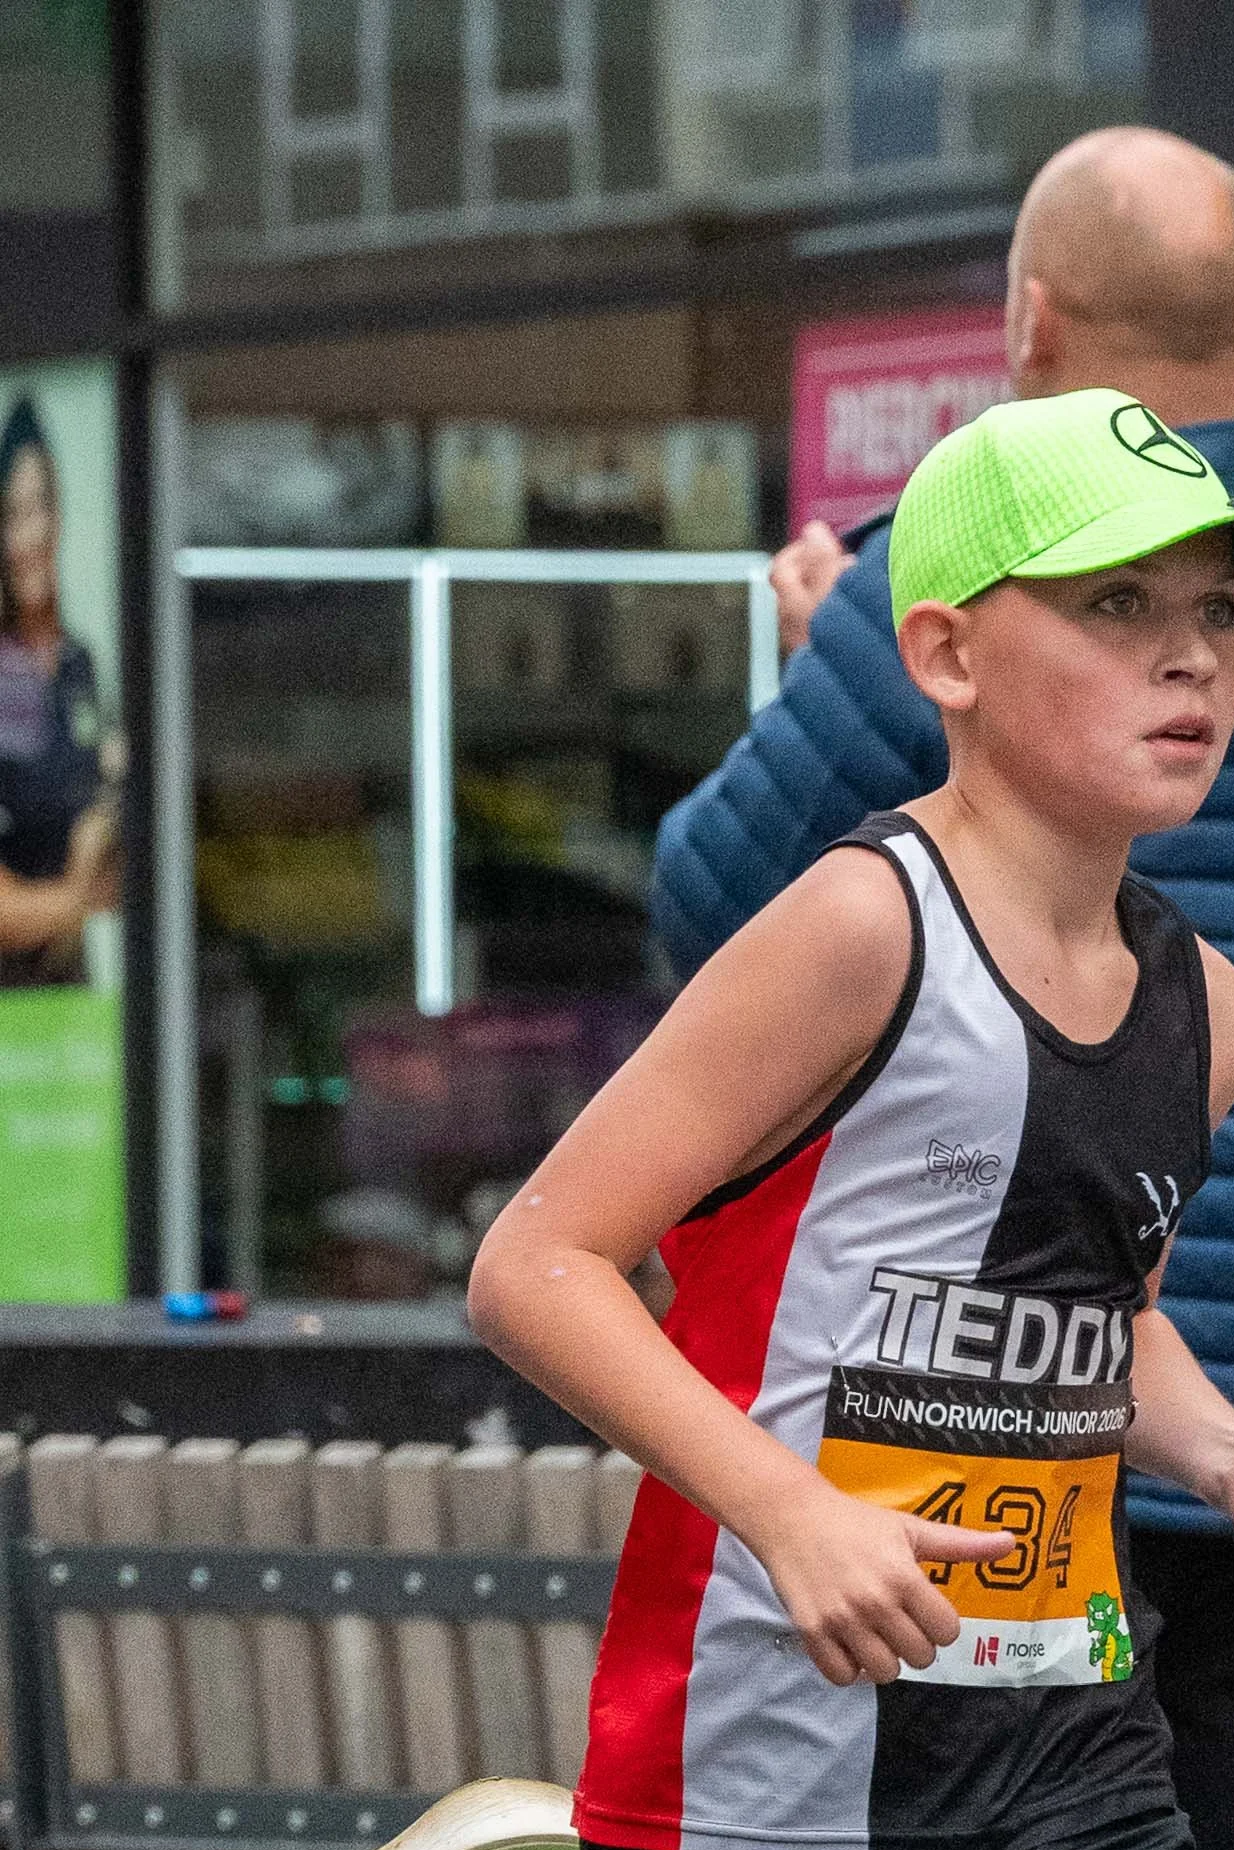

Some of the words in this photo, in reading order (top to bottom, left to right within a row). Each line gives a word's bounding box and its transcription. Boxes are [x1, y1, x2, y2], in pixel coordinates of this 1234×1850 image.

[925, 1138, 1002, 1187] EPIC
[869, 1266, 1130, 1386] TEDDY
[1036, 1410, 1098, 1435] JUNIOR
[1096, 1406, 1127, 1433] 2026
[1005, 1641, 1046, 1658] norse
